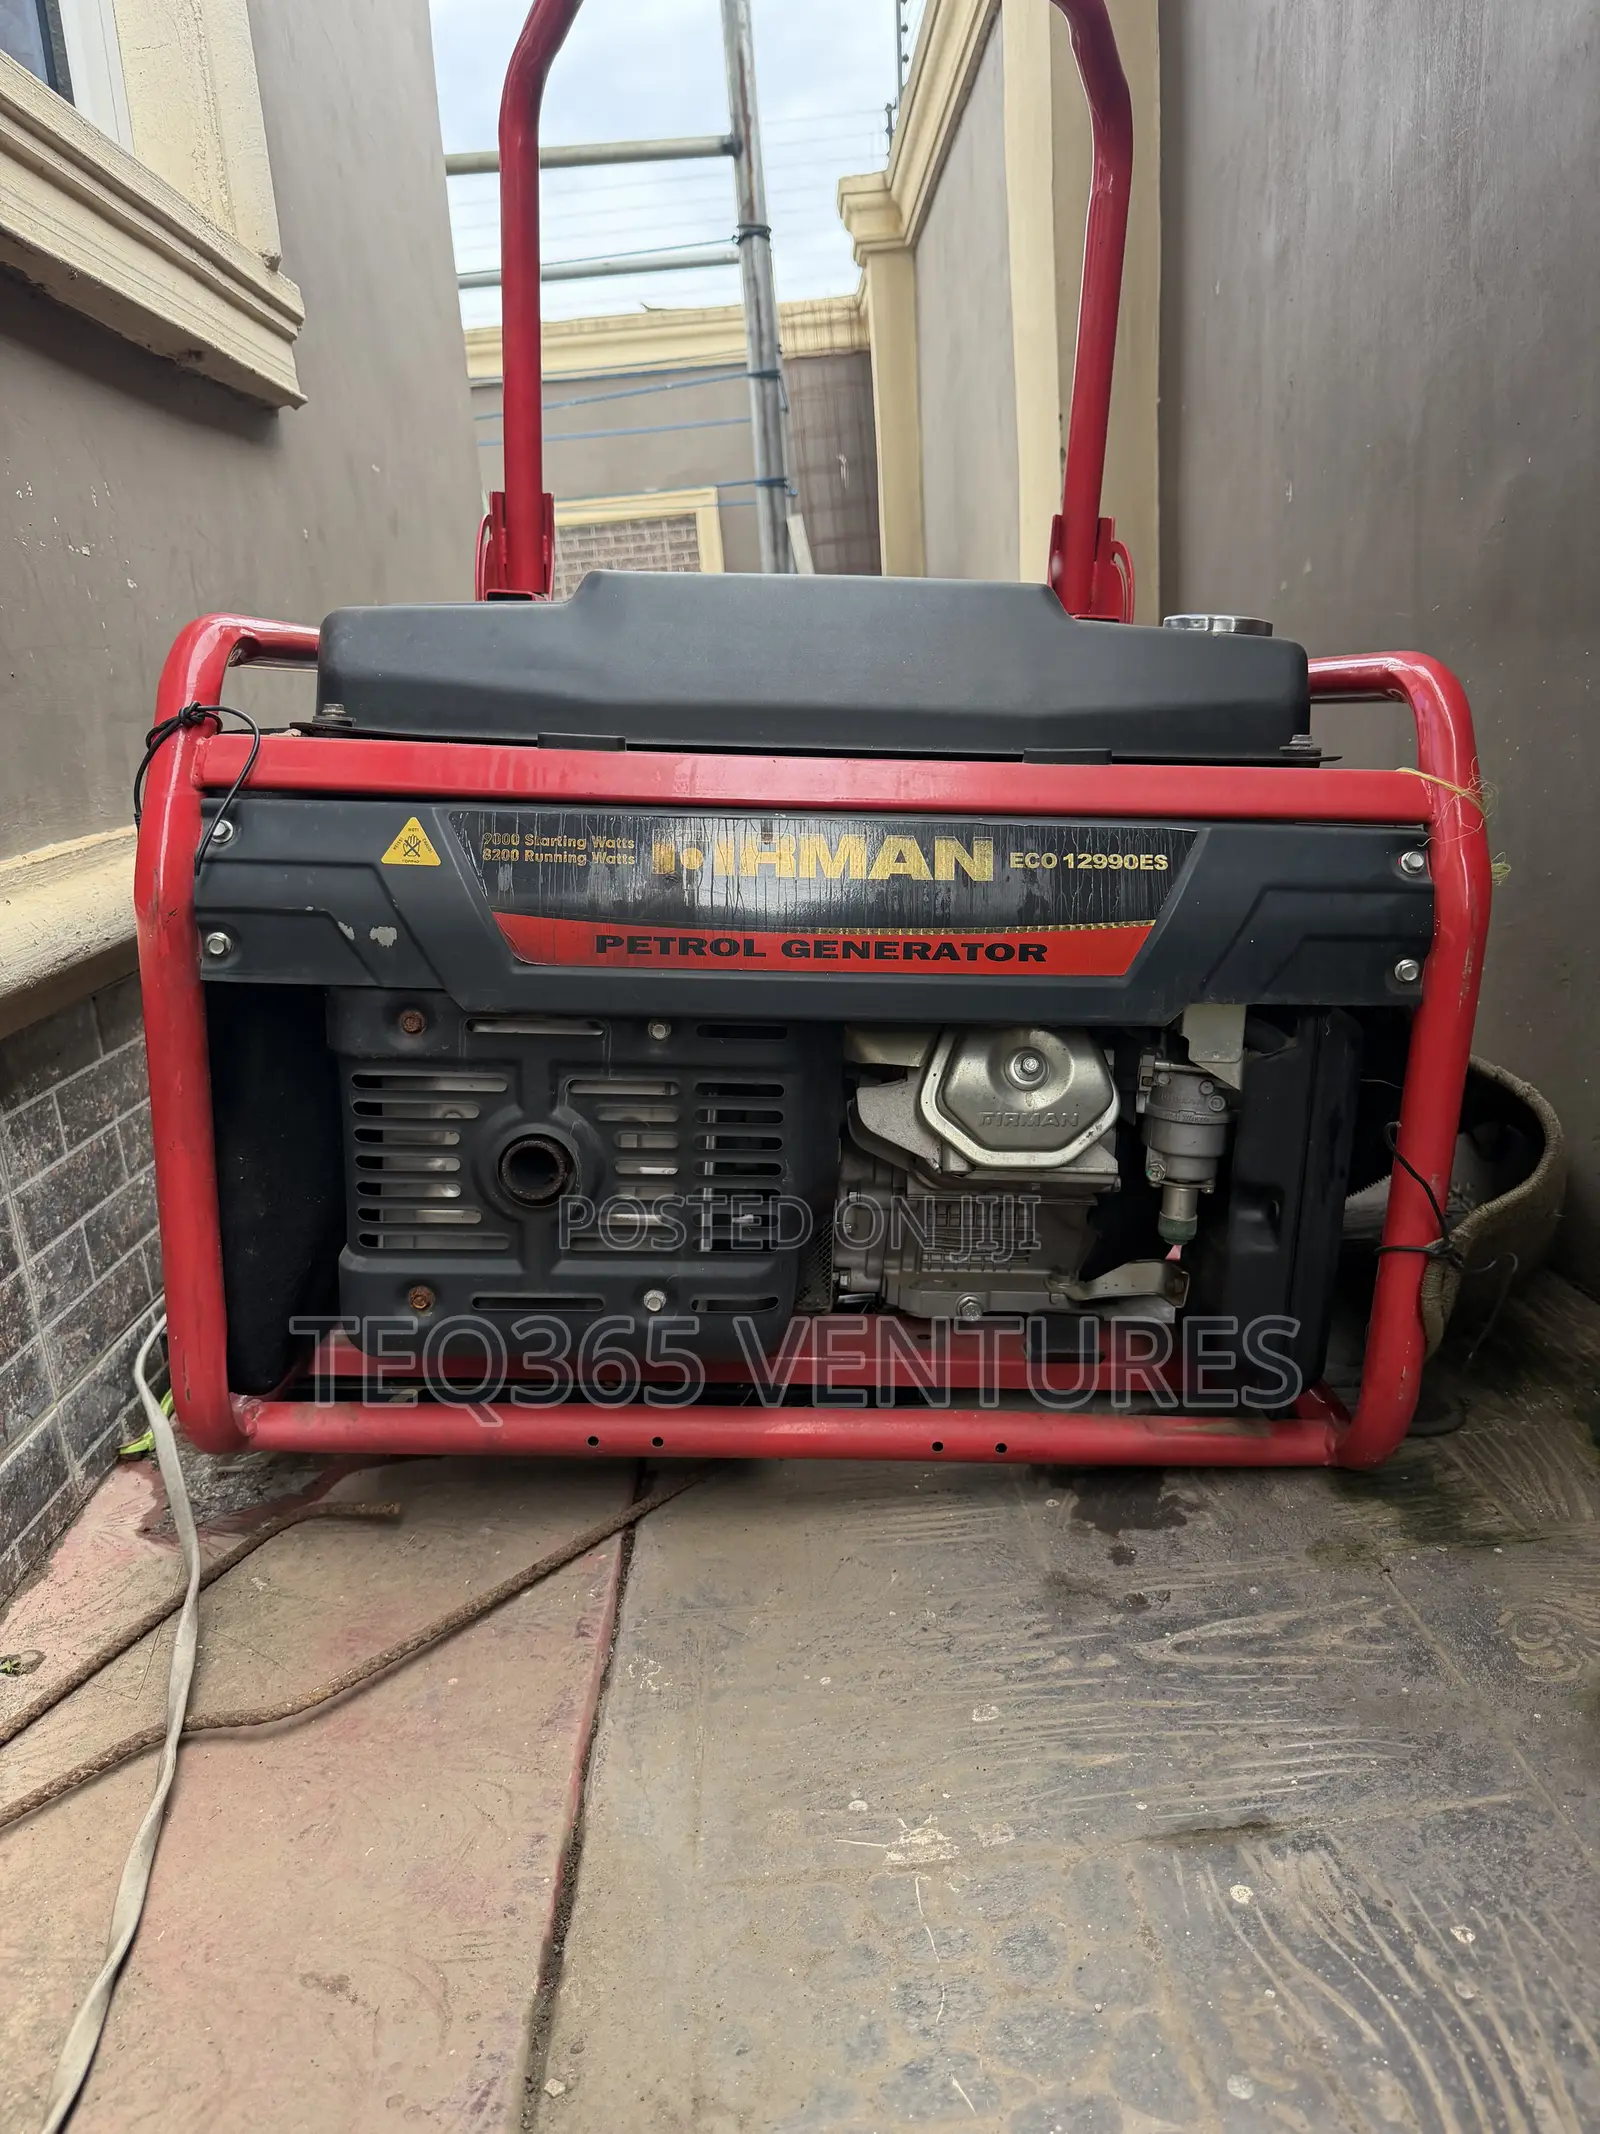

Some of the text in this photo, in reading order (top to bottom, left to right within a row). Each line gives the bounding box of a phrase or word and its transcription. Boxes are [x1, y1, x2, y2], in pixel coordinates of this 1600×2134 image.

[483, 833, 635, 850] 9000 Starting Watts
[482, 848, 635, 866] 8200 Running Watts
[1009, 852, 1169, 871] ECO 12990ES
[595, 934, 1048, 963] PETROL GENERATOR
